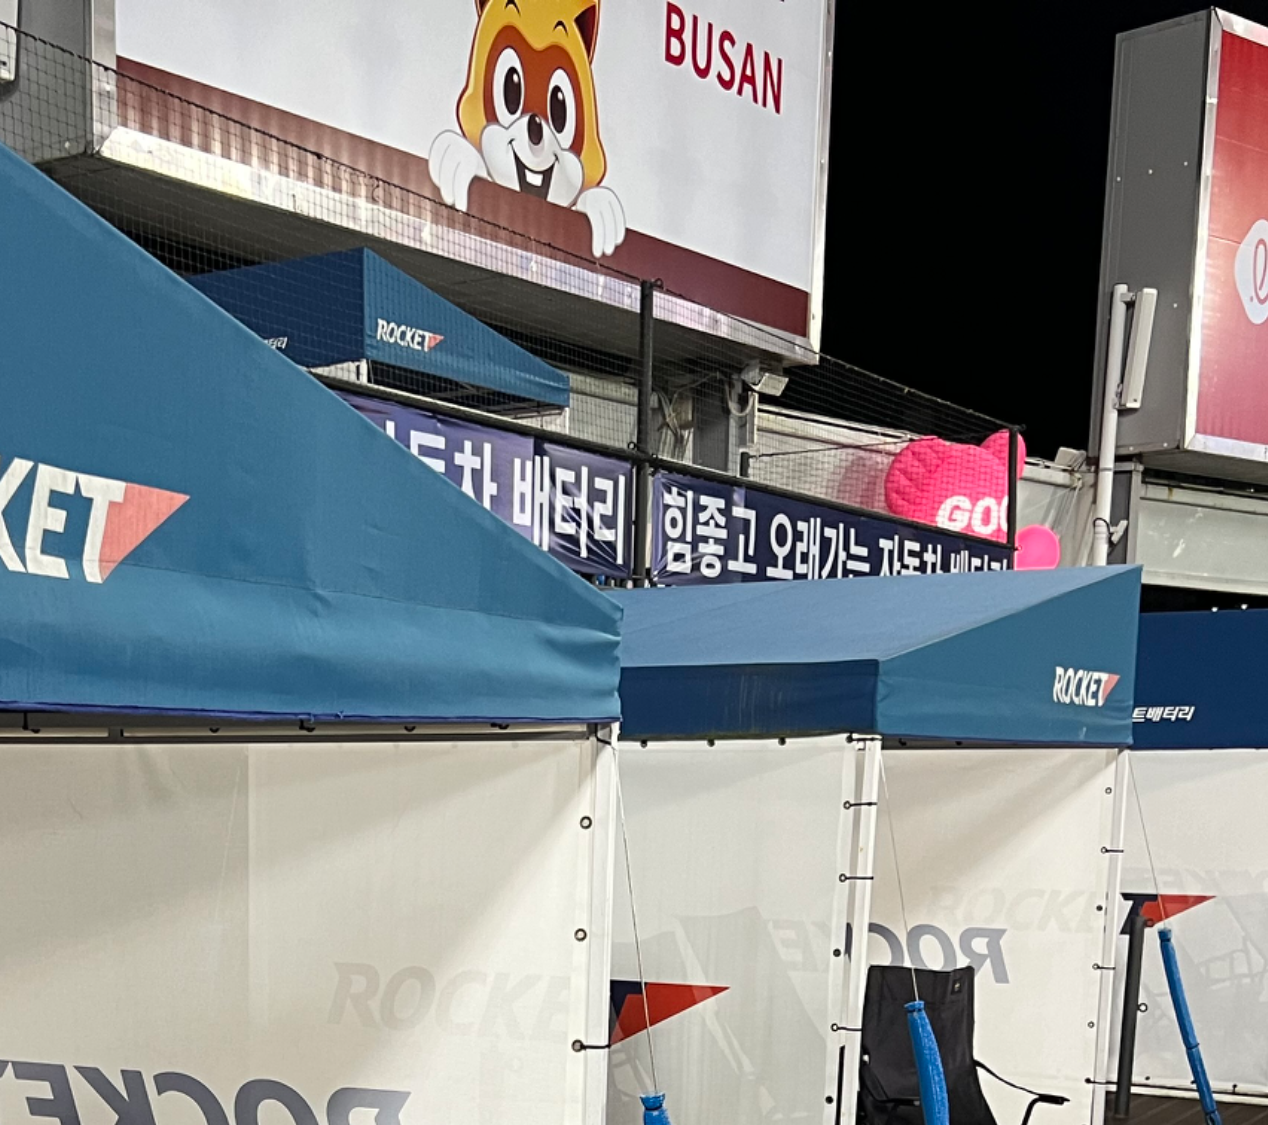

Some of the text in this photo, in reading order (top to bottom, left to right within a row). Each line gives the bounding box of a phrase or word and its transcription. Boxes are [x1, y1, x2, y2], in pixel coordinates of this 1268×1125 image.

[664, 1, 783, 115] BUSAN
[377, 318, 432, 352] ROCKET
[512, 455, 626, 565] 배터리
[663, 486, 758, 578] 힘좋고
[1053, 666, 1110, 707] ROCKET
